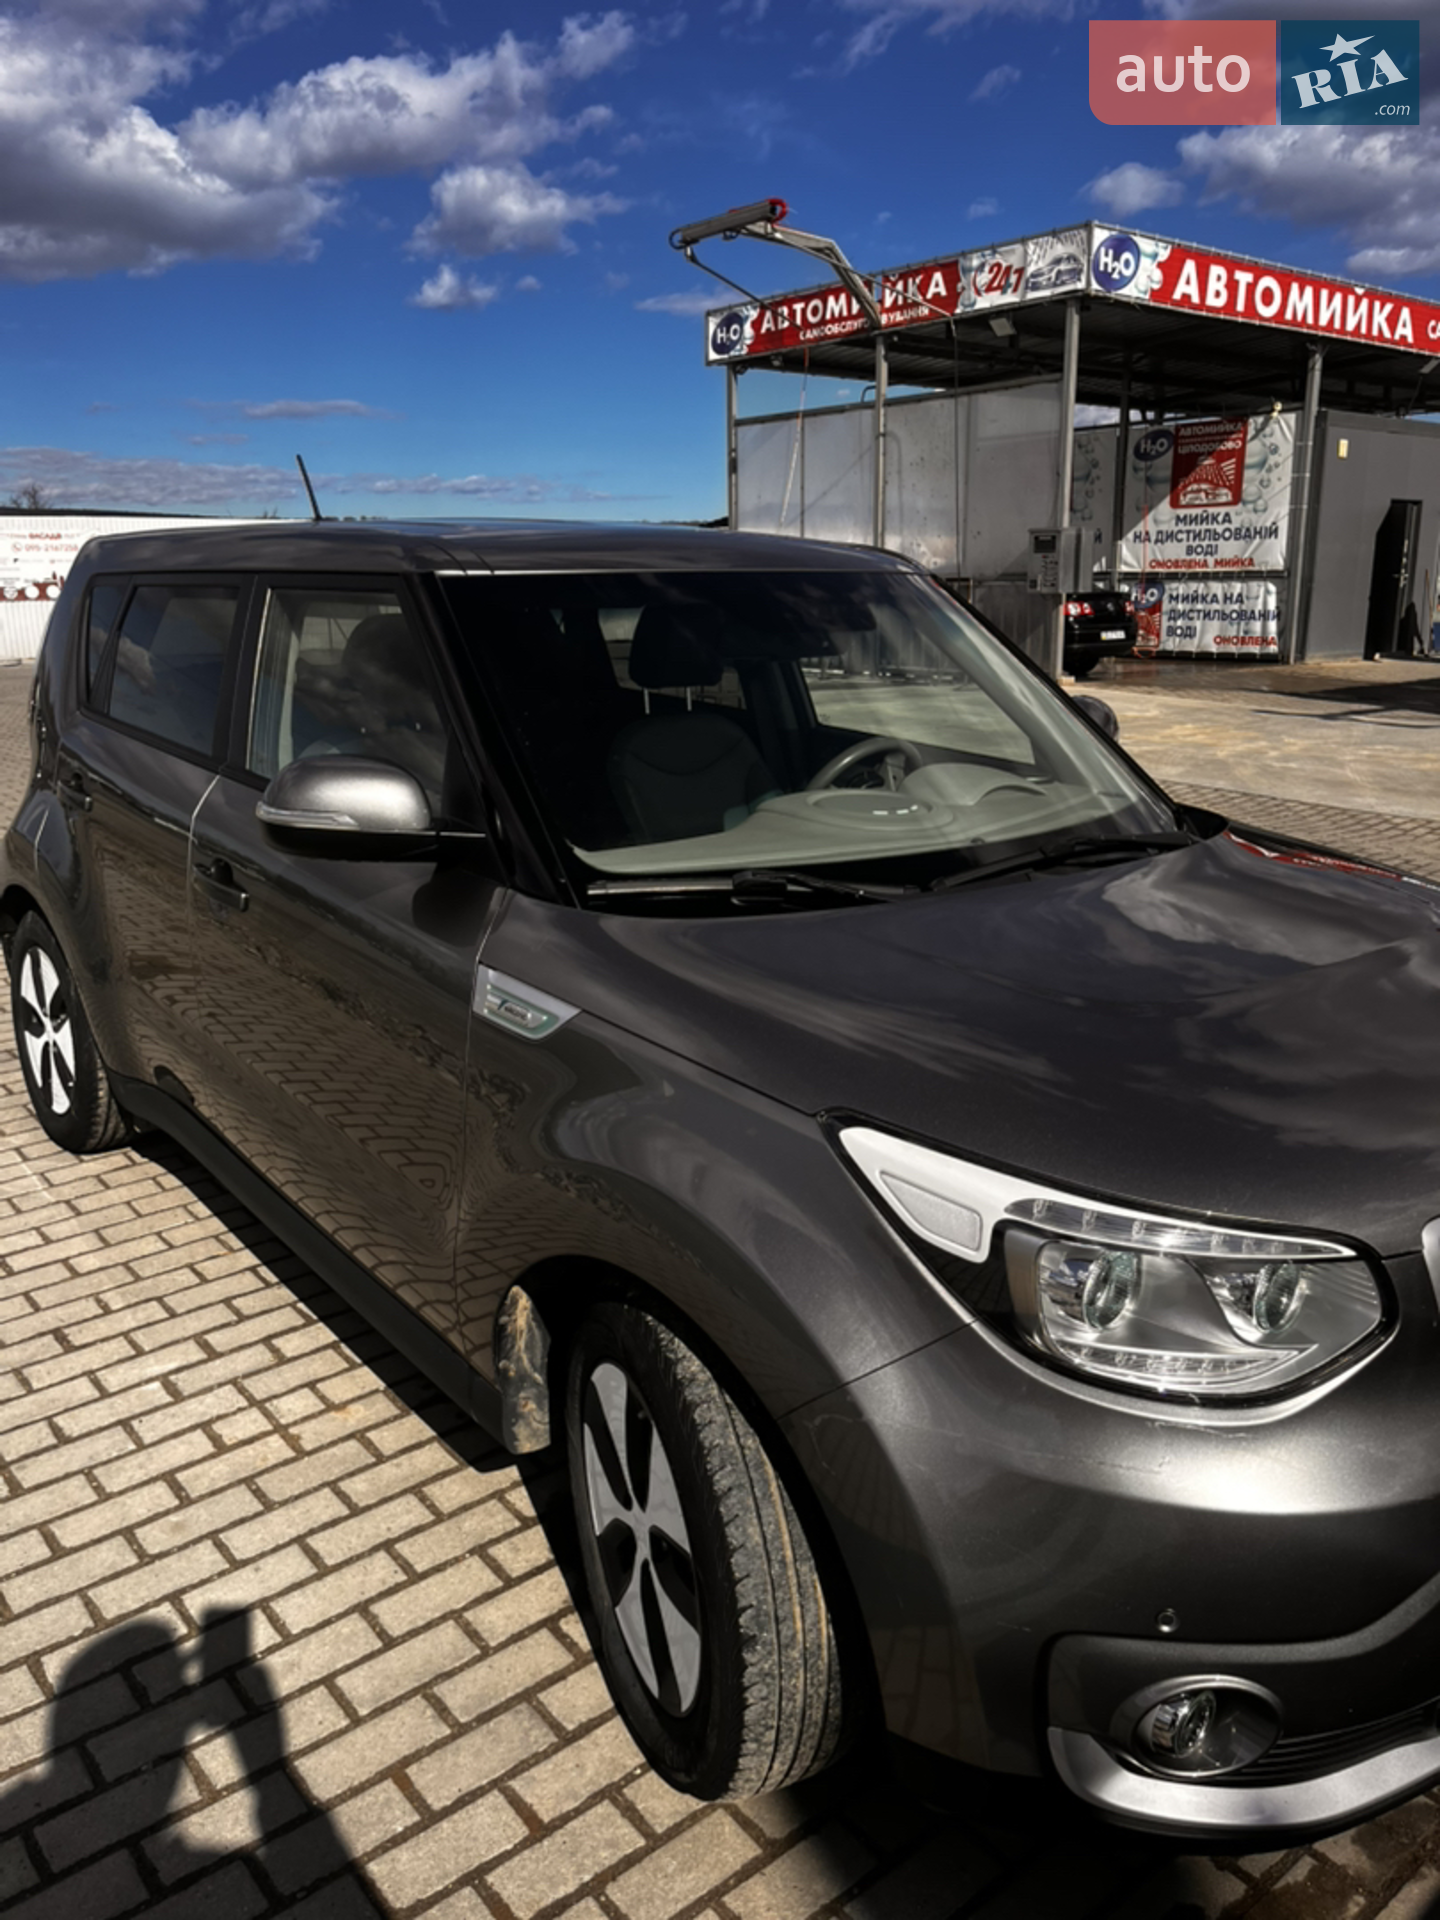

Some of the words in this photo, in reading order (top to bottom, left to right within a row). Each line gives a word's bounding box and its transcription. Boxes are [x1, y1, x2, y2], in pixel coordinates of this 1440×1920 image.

[1172, 258, 1415, 344] АВТОМИЙКА
[1179, 421, 1243, 436] АВТОМИЙКА
[1175, 510, 1232, 526] МИЙКА
[1133, 531, 1151, 543] НА
[1154, 521, 1279, 545] ДИСТИЛЬОВАНІЙ
[1186, 544, 1219, 557] ВОДІ
[1149, 558, 1209, 569] ОНОВЛЕНА
[1214, 555, 1255, 568] МИЙКА
[1168, 590, 1220, 605] МИЙКА
[1223, 592, 1245, 605] НА
[1167, 607, 1281, 622] ДИСТИЛЬОВАНІЙ
[1165, 625, 1197, 638] ВОДІ
[1213, 635, 1278, 646] ОНОВЛЕНА
